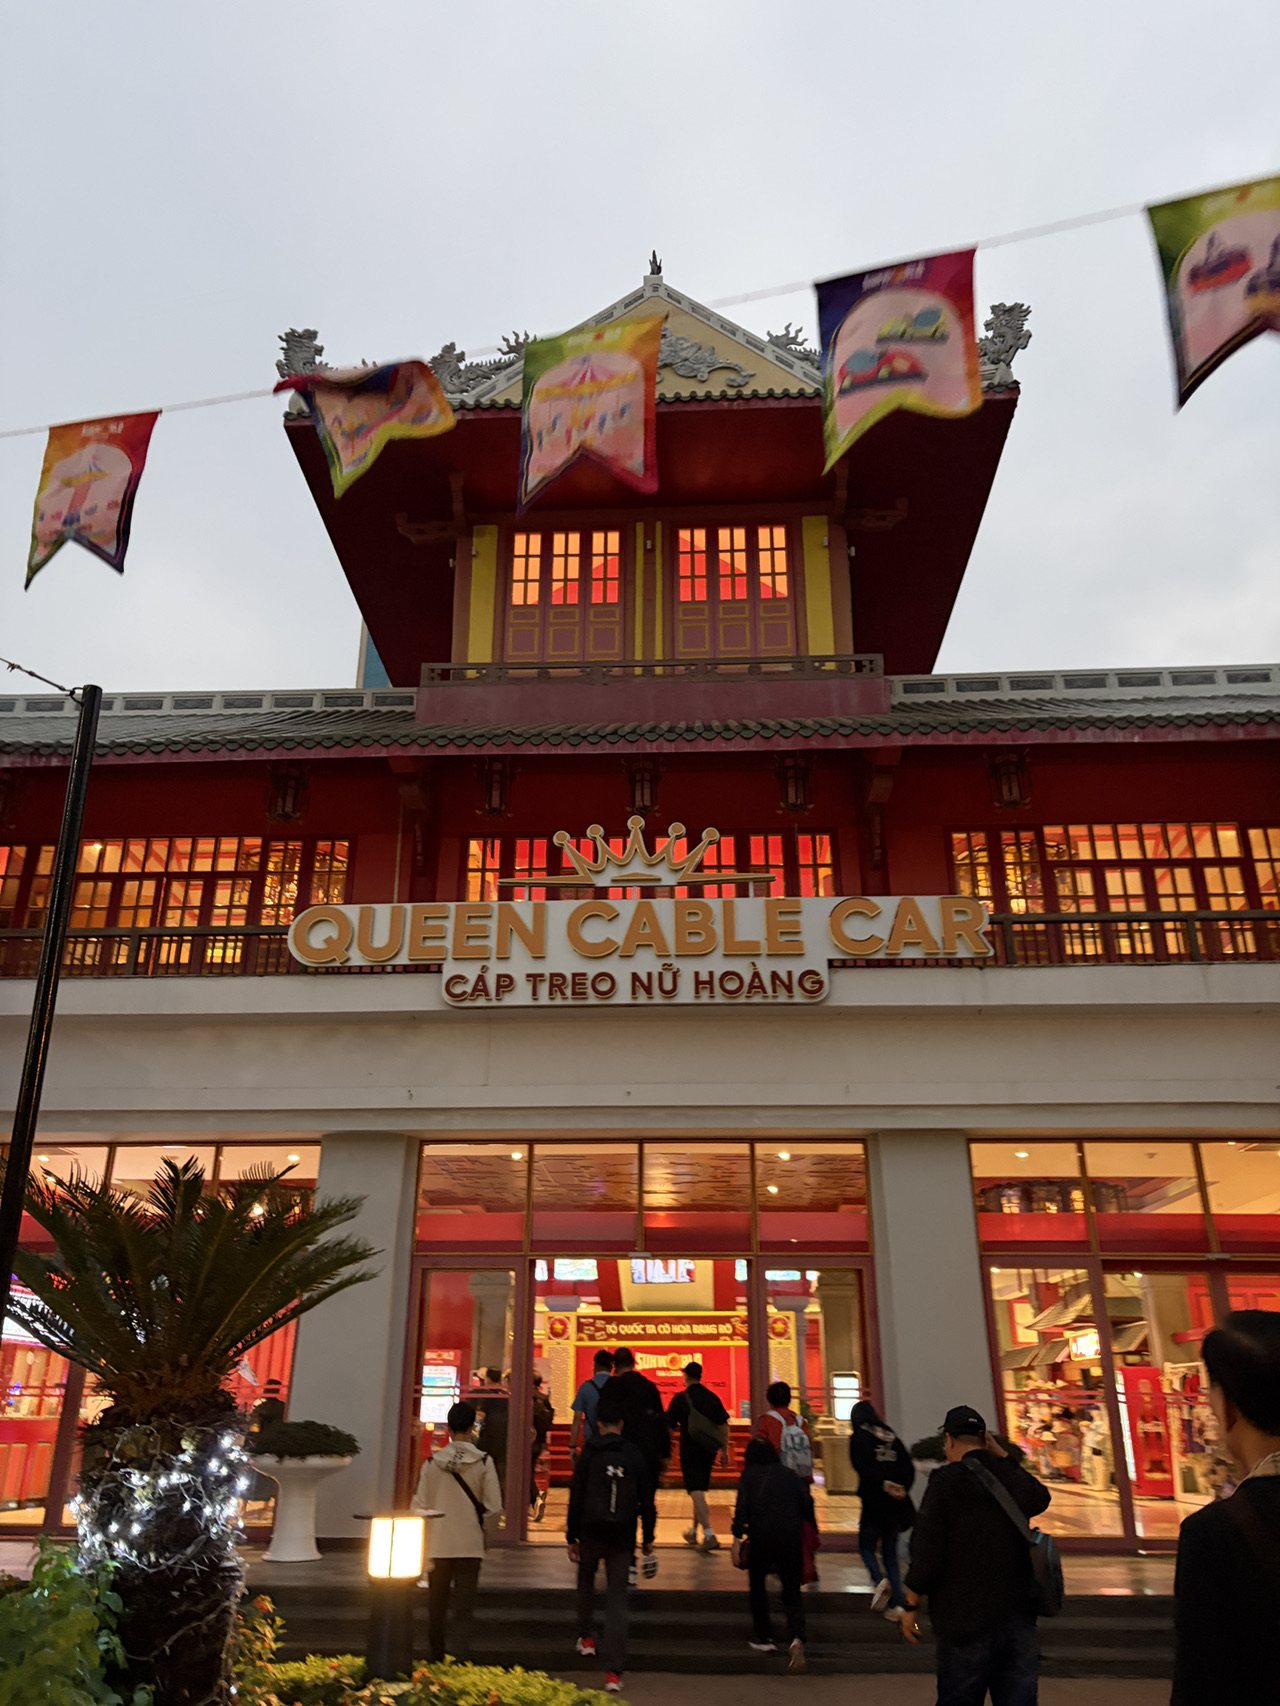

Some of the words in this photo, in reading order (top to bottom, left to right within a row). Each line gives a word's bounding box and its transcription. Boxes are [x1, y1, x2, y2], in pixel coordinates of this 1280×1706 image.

[293, 901, 547, 965] QUEEN
[566, 899, 806, 958] CABLE
[829, 897, 990, 955] CAR
[445, 965, 516, 1001] CÁP
[526, 971, 617, 1000] TREO
[631, 962, 680, 998] NỮ
[694, 961, 825, 998] HOÀNG
